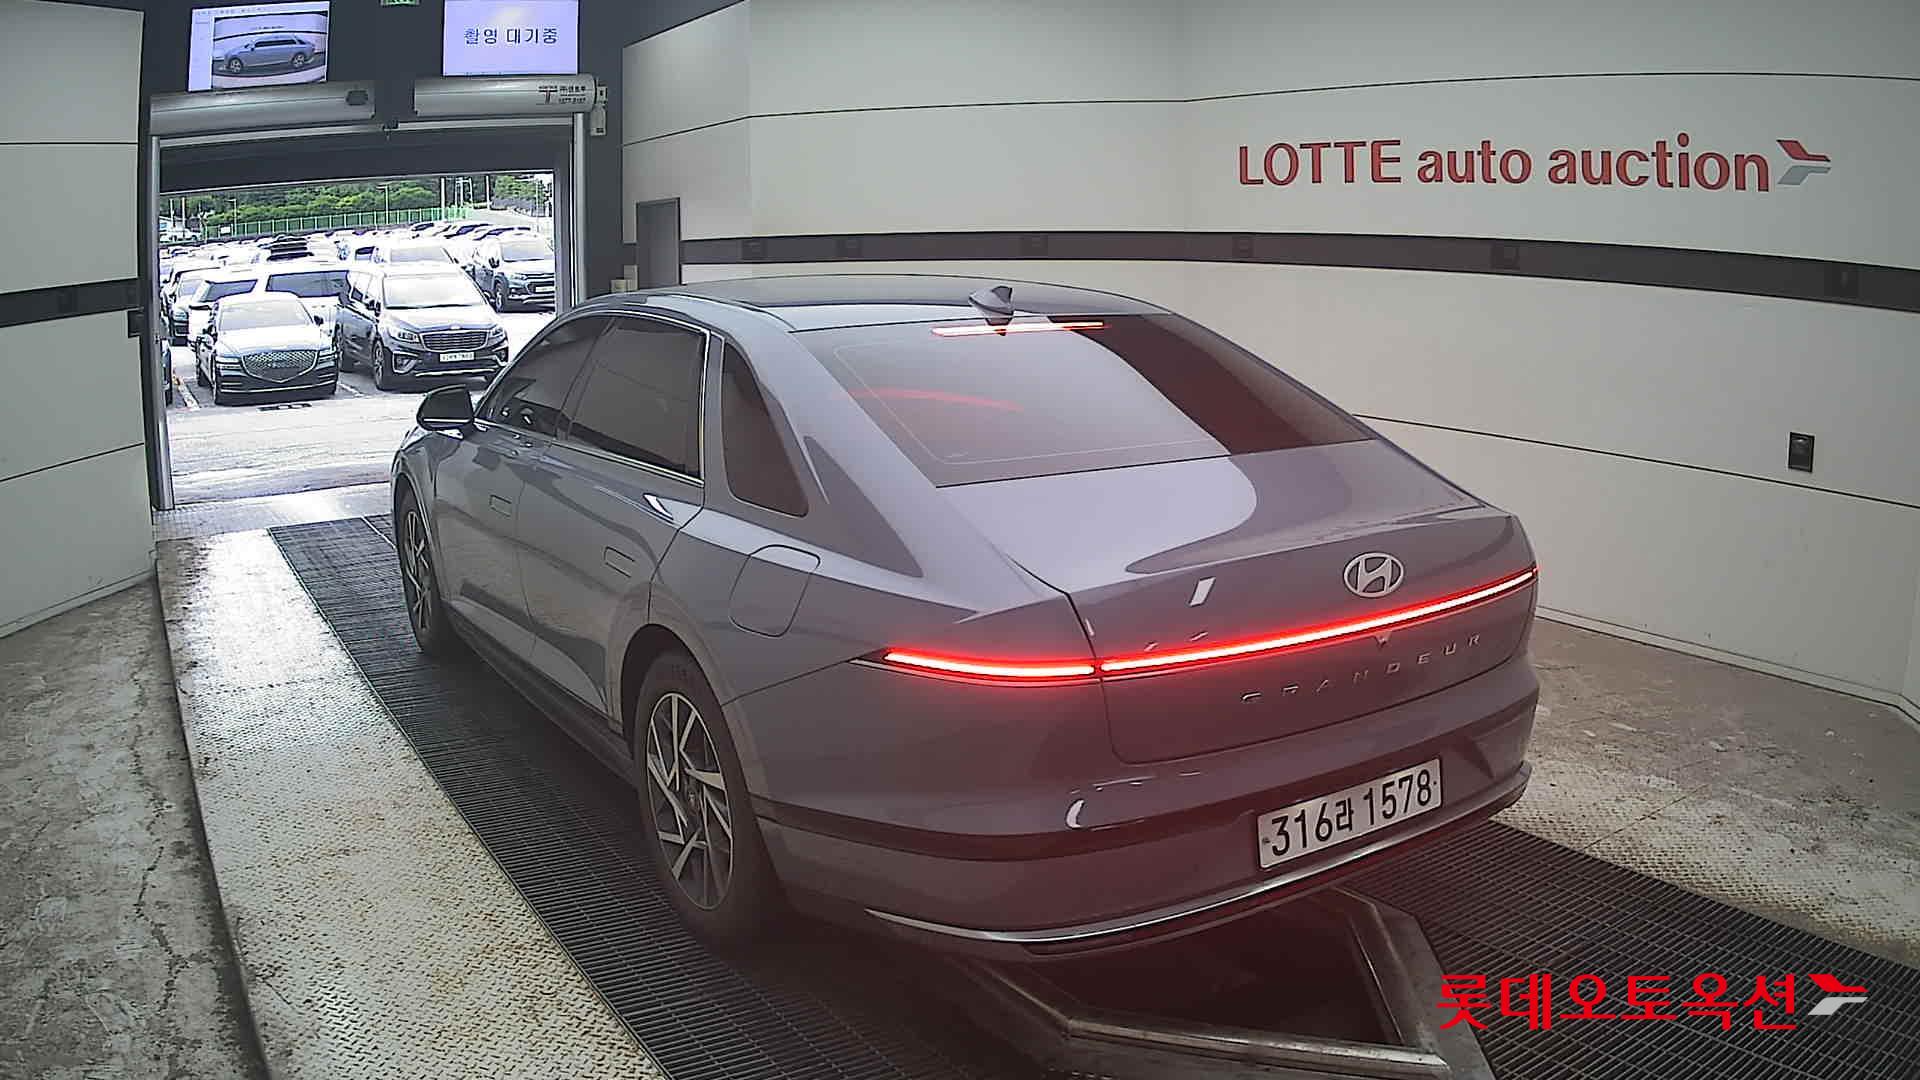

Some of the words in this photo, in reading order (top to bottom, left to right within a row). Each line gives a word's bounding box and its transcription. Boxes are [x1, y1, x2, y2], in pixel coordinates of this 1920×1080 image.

[463, 27, 499, 46] 촬영
[505, 27, 559, 45] 대기중
[1239, 139, 1402, 185] LOTTE
[1416, 141, 1533, 185] auto
[1548, 133, 1771, 192] auction
[1270, 797, 1355, 857] 316라
[1363, 768, 1432, 827] 1578
